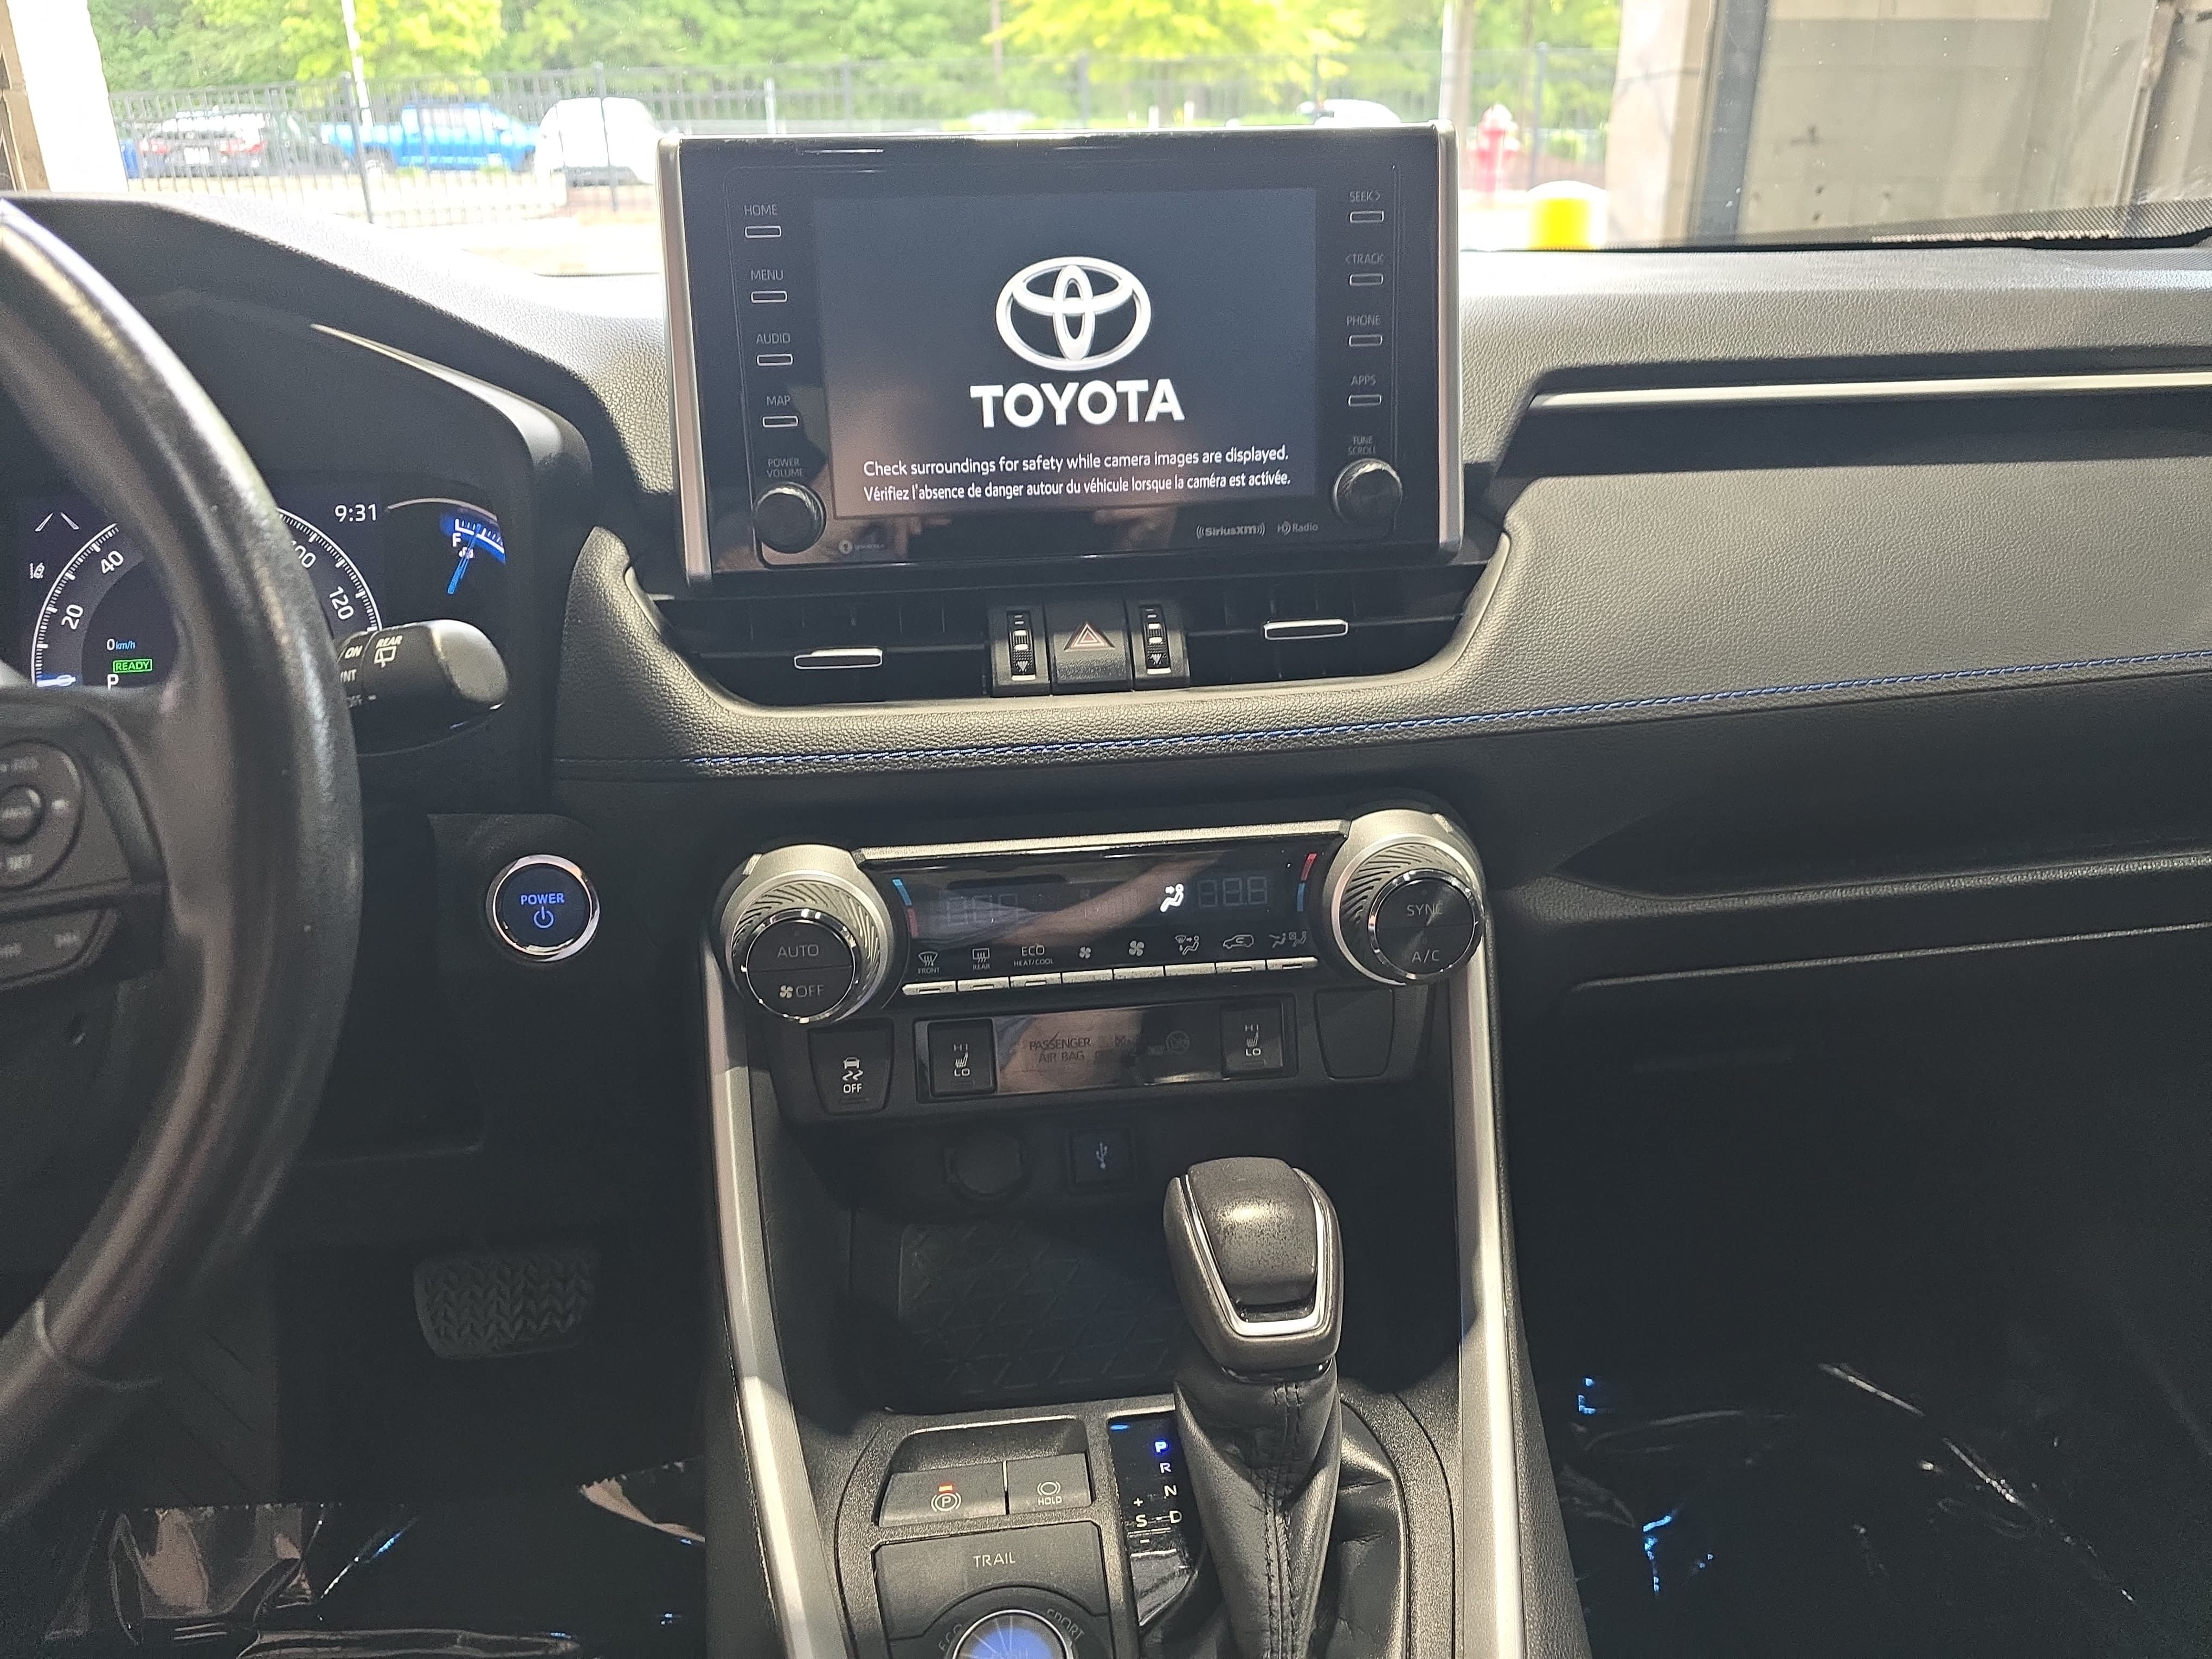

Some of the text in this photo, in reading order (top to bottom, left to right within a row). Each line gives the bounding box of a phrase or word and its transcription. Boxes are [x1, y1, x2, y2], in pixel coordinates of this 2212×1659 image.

[744, 204, 777, 216] HOME
[751, 269, 783, 281] MENU
[1346, 314, 1381, 326] PHONE
[756, 333, 790, 344] AUDIO
[1351, 375, 1376, 386] APPS
[767, 395, 790, 406] MAP
[970, 379, 1185, 428] TOYOTA
[1353, 435, 1373, 445] TUNE
[768, 458, 800, 467] POWER
[864, 445, 1289, 477] Check surroundings for safety while camera images are displayed.
[766, 468, 804, 478] VOLUME
[864, 470, 1291, 502] Vérifiez l'absence de danger autour du véhicule lorsque la caméra est activée.
[335, 504, 376, 522] 9:31
[1293, 522, 1319, 532] Radio
[452, 532, 461, 547] F
[100, 550, 124, 574] 40
[329, 586, 354, 620] 120
[61, 604, 83, 630] 20
[375, 635, 403, 649] REAR
[344, 645, 363, 659] ON
[115, 661, 149, 671] READY
[107, 674, 119, 690] P
[520, 893, 565, 905] POWER
[1407, 903, 1443, 917] SYNC
[777, 944, 819, 959] AUTO
[1022, 944, 1045, 956] ECO
[1412, 949, 1440, 963] A/C
[1014, 958, 1053, 967] HEAT/COOL
[917, 967, 940, 975] FRONT
[796, 985, 824, 998] OFF
[1030, 1037, 1091, 1051] PASSENGER
[1039, 1051, 1085, 1063] AIR BAG
[1246, 1048, 1261, 1056] LO
[954, 1068, 970, 1077] LO
[843, 1083, 862, 1094] OFF
[1155, 1441, 1167, 1453] P
[1160, 1462, 1172, 1474] R
[1165, 1485, 1177, 1497] N
[1038, 1496, 1062, 1506] HOLD
[1136, 1510, 1182, 1527] S D
[973, 1552, 1015, 1568] TRAIL
[938, 1624, 962, 1652] ECO
